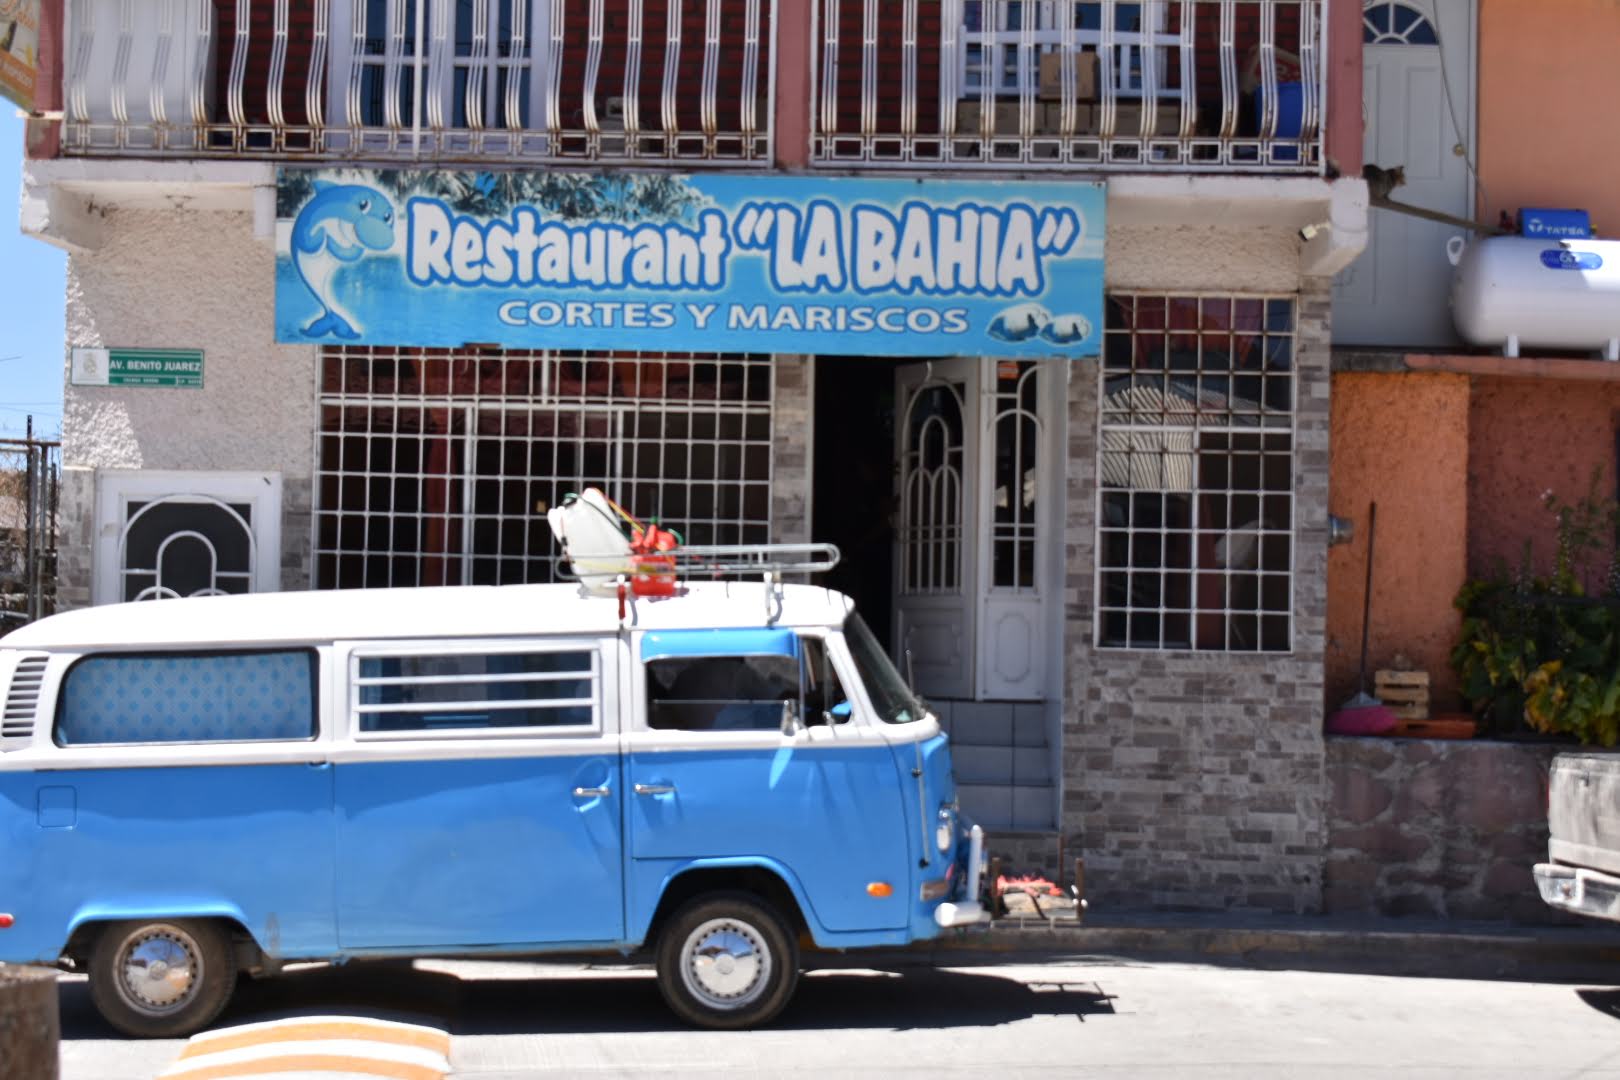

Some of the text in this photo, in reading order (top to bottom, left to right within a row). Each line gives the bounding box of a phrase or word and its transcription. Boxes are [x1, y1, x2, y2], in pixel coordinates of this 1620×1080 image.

[408, 198, 730, 289] Restaurant
[498, 301, 968, 334] CORTES Y MARISCOS
[109, 360, 201, 371] AV. BENITO JUAREZ
